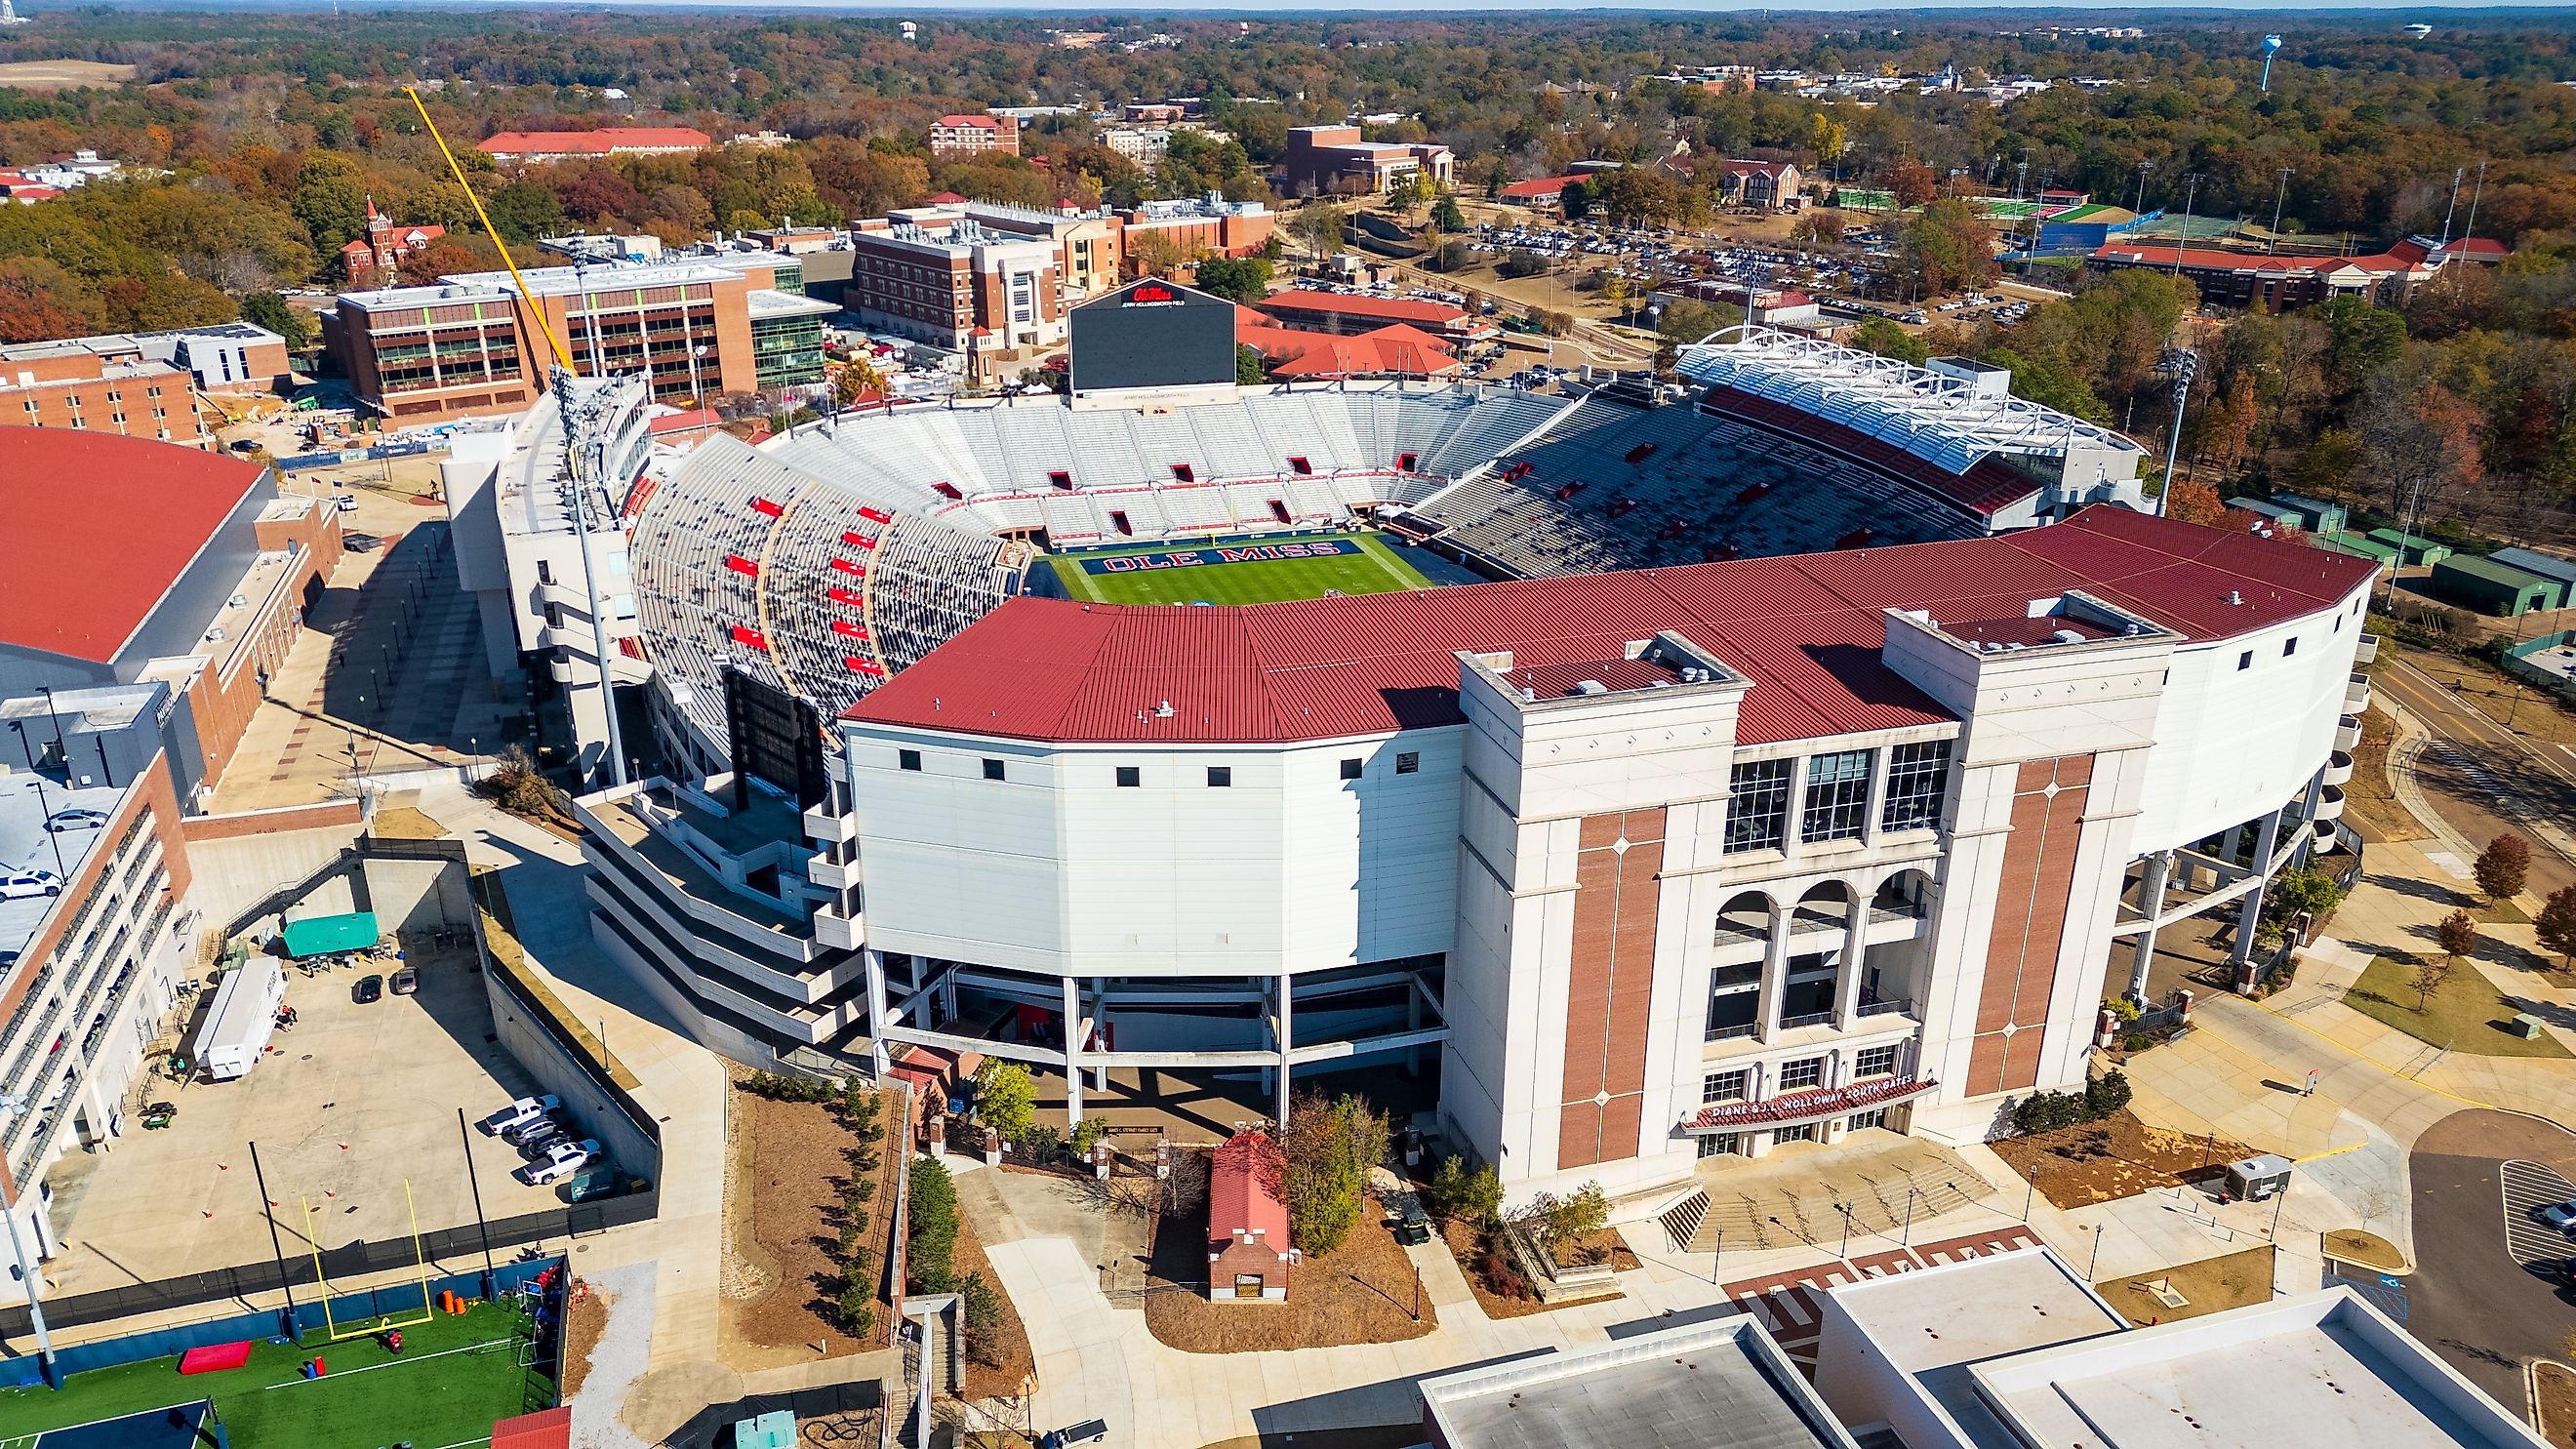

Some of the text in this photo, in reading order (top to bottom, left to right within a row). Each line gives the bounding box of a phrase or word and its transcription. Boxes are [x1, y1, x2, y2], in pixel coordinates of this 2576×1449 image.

[1104, 542, 1342, 572] OLE MISS
[1712, 1073, 1912, 1117] DIANE & J.L. HOLLOWAY SOUTH GATES
